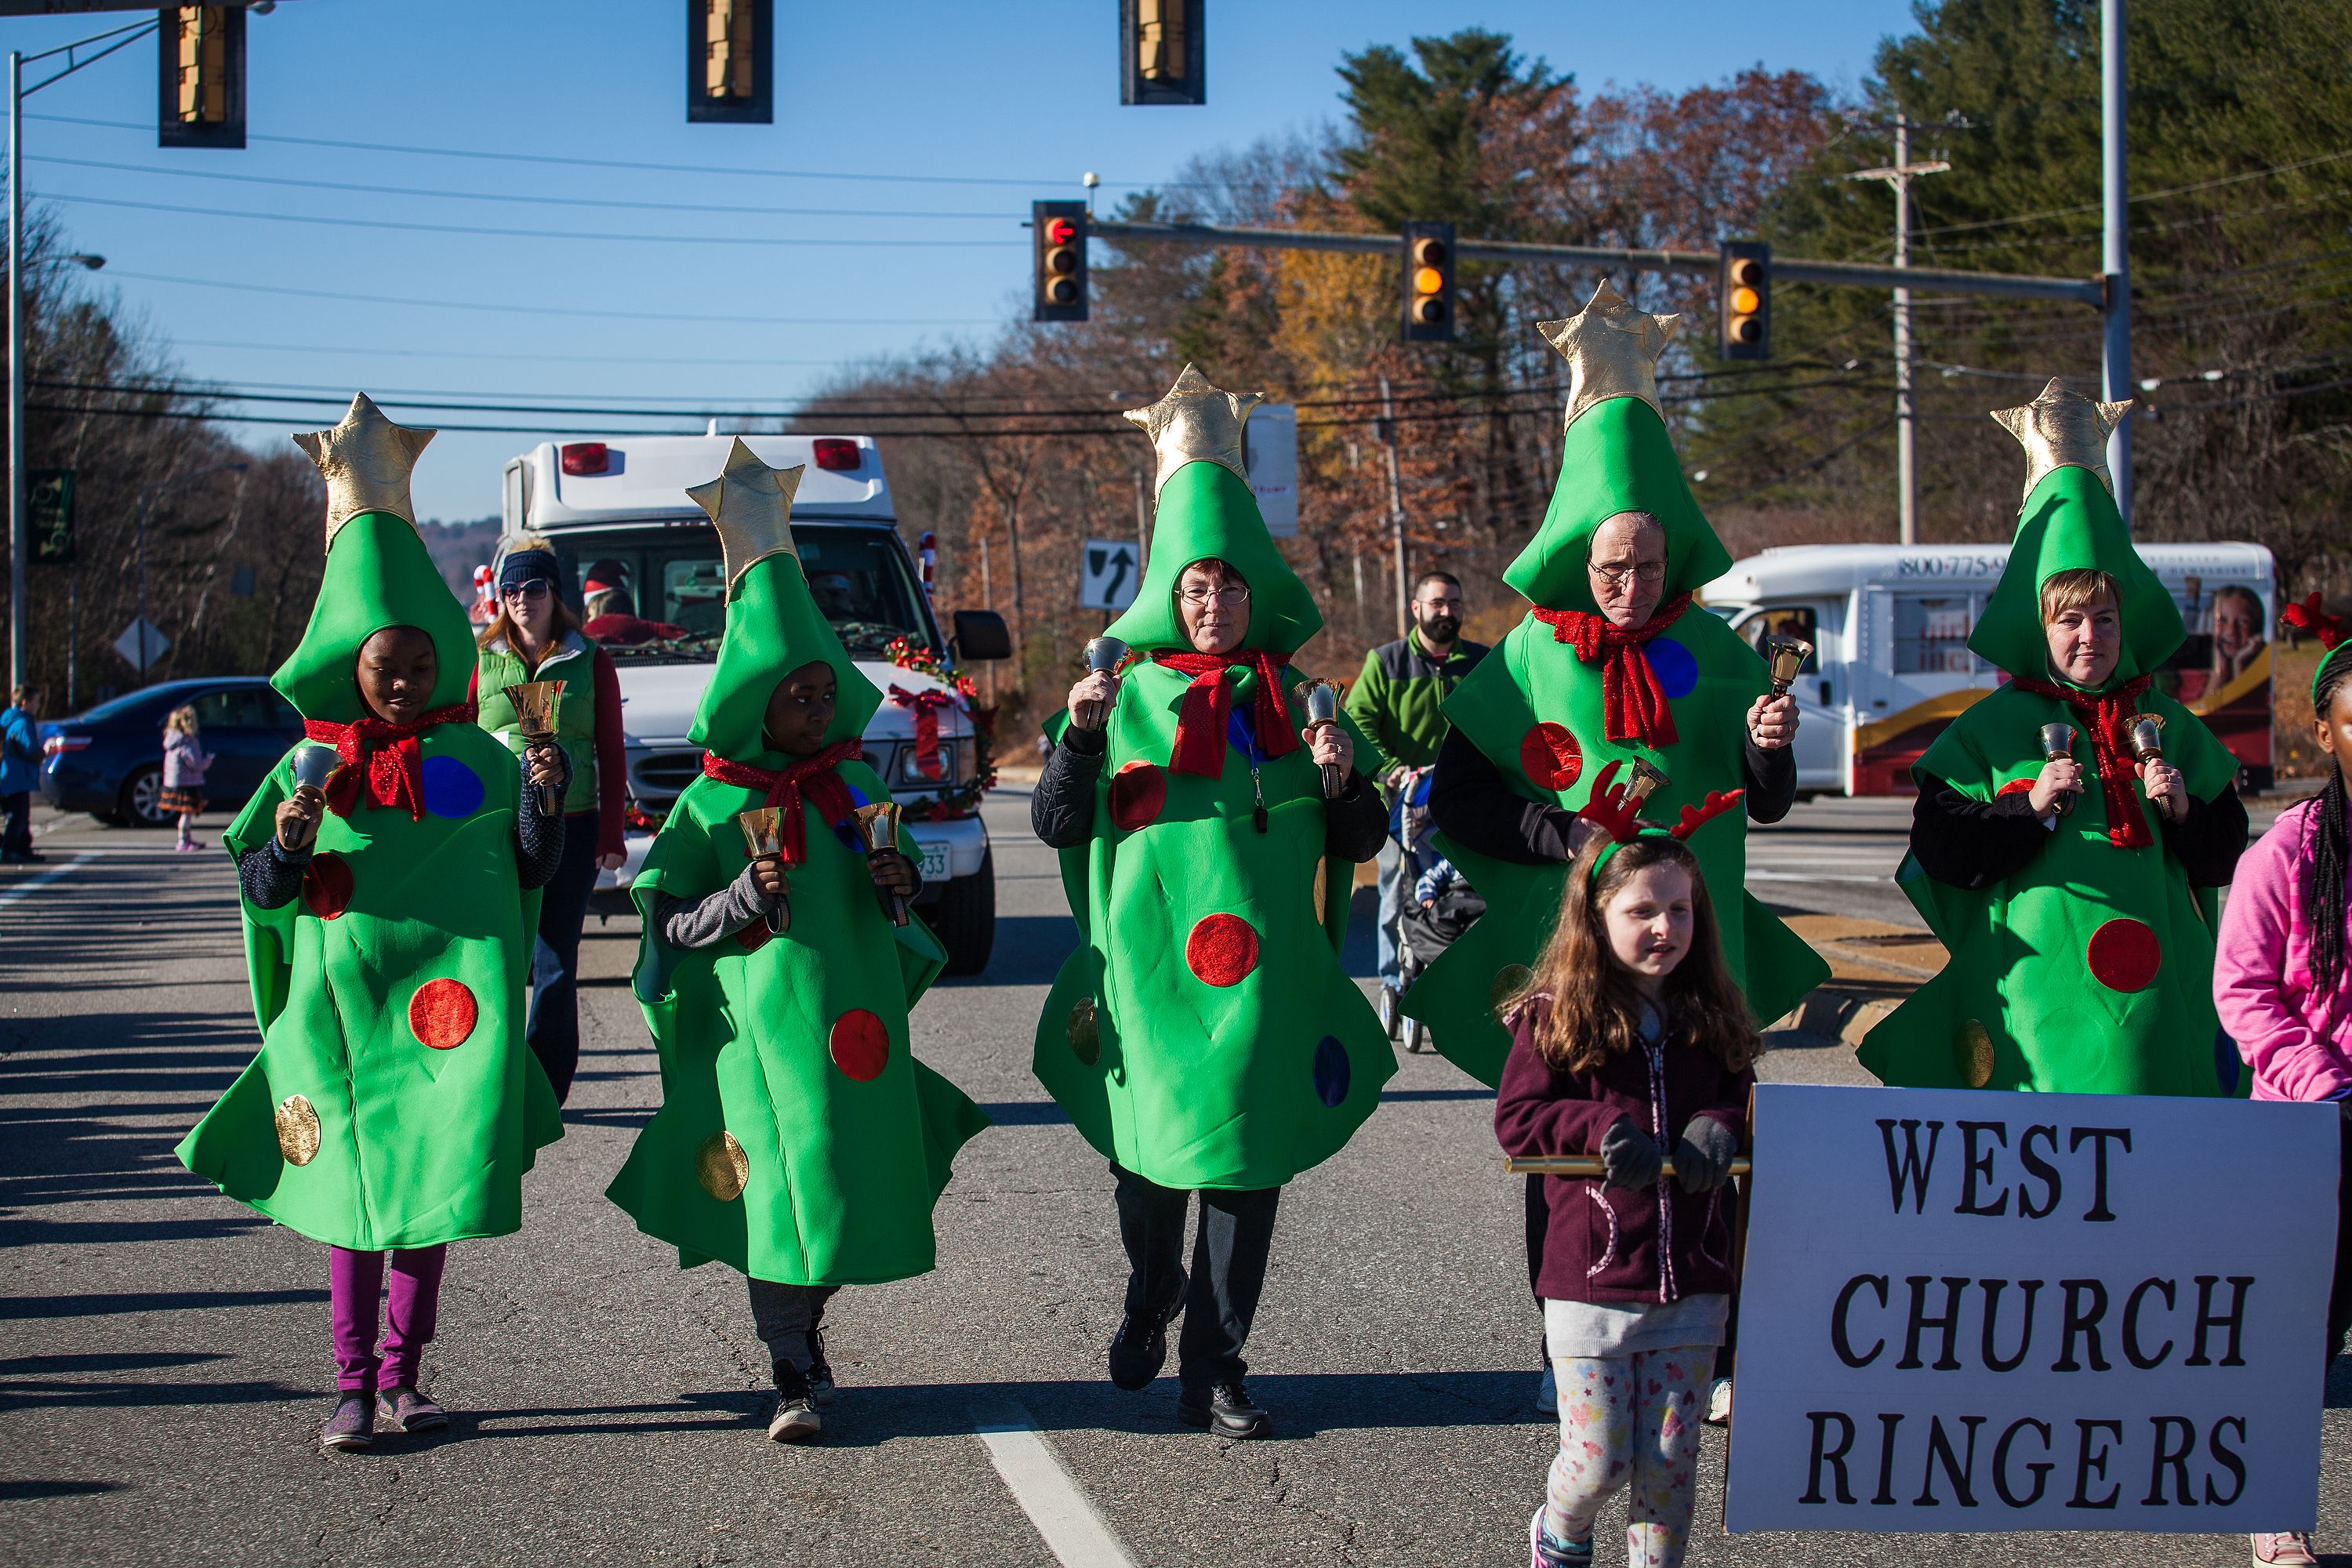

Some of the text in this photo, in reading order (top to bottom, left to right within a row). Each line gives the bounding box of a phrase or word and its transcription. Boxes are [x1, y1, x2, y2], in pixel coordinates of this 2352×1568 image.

[1875, 1119, 2132, 1222] WEST
[1831, 1274, 2256, 1373] CHURCH
[1798, 1412, 2247, 1509] RINGERS
